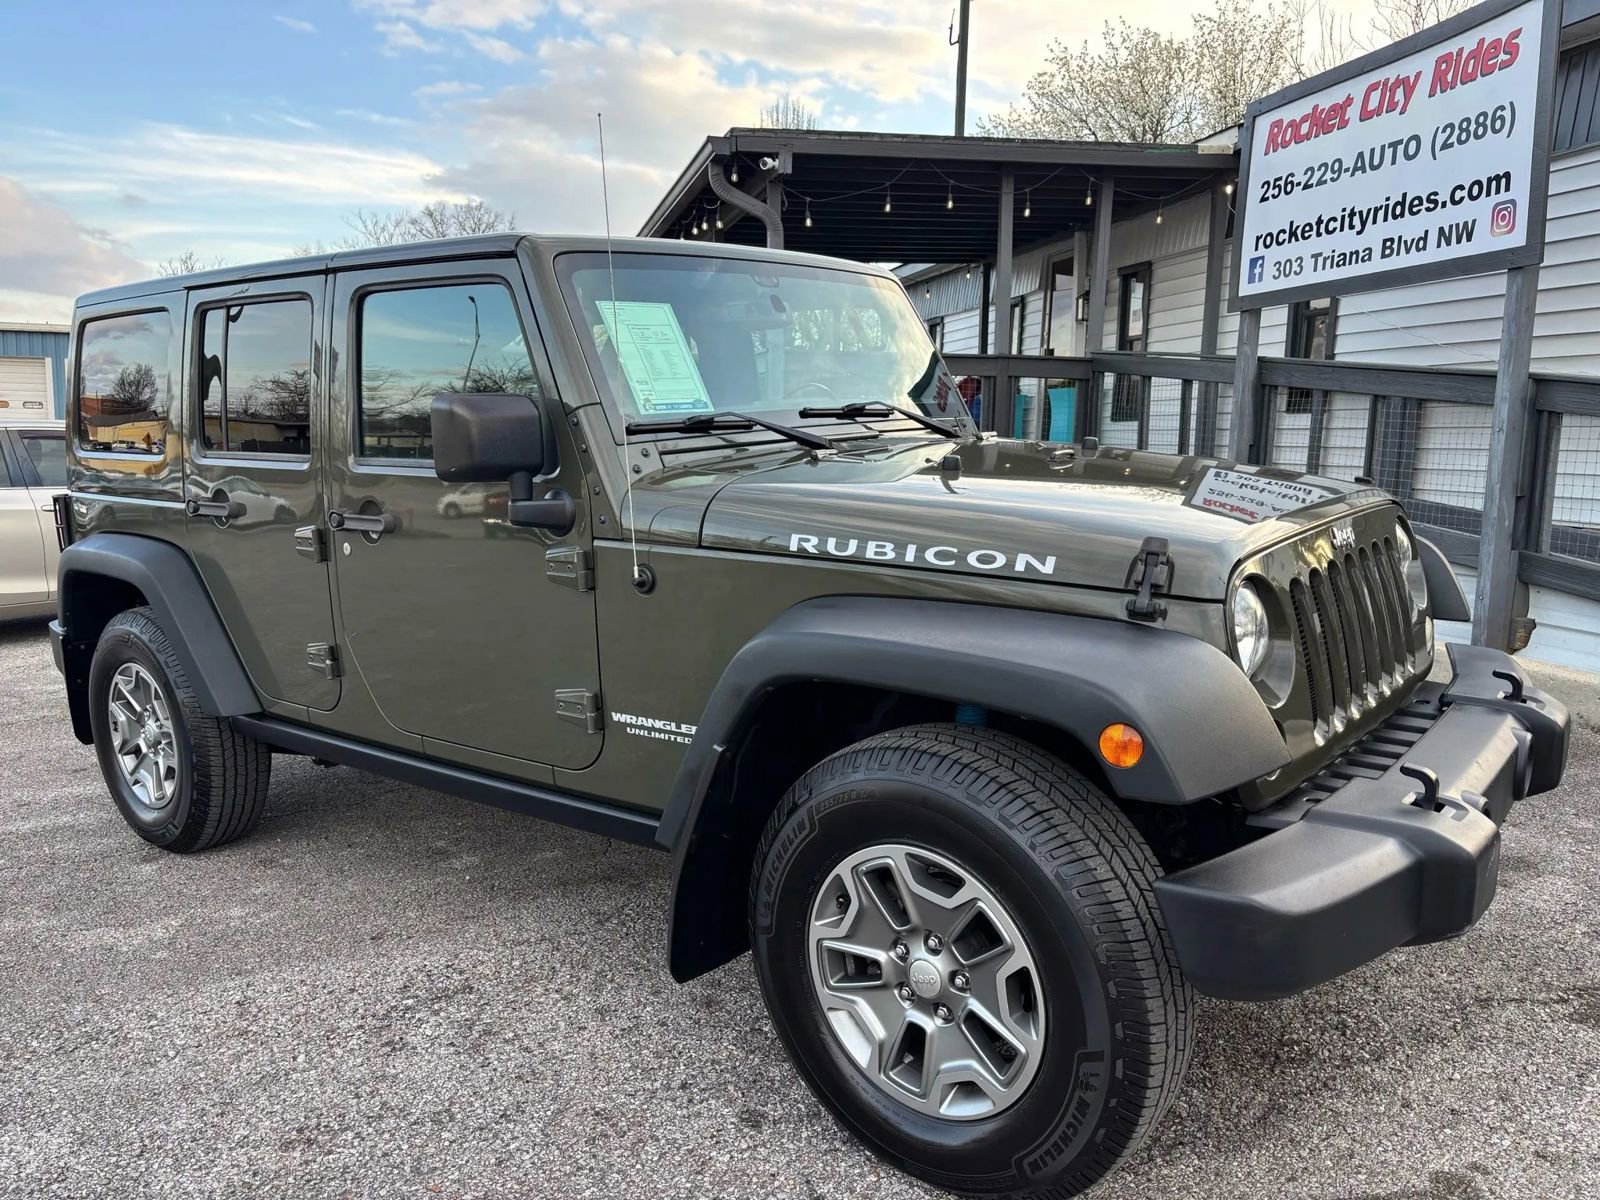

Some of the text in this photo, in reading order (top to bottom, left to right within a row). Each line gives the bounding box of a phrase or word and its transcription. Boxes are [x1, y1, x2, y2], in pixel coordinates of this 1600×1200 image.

[1264, 27, 1523, 155] Rocket City Rides
[1259, 101, 1517, 203] 256-229-AUTO (2886)
[1254, 170, 1512, 252] rocketcityrides.com
[1272, 219, 1477, 281] 303 Triana Blvd NW
[789, 533, 1057, 575] RUBICON
[626, 727, 693, 744] UNLIMITED
[763, 817, 808, 898] MICHELIN
[912, 972, 937, 985] Jeep
[1027, 1095, 1091, 1176] MICHELIN
